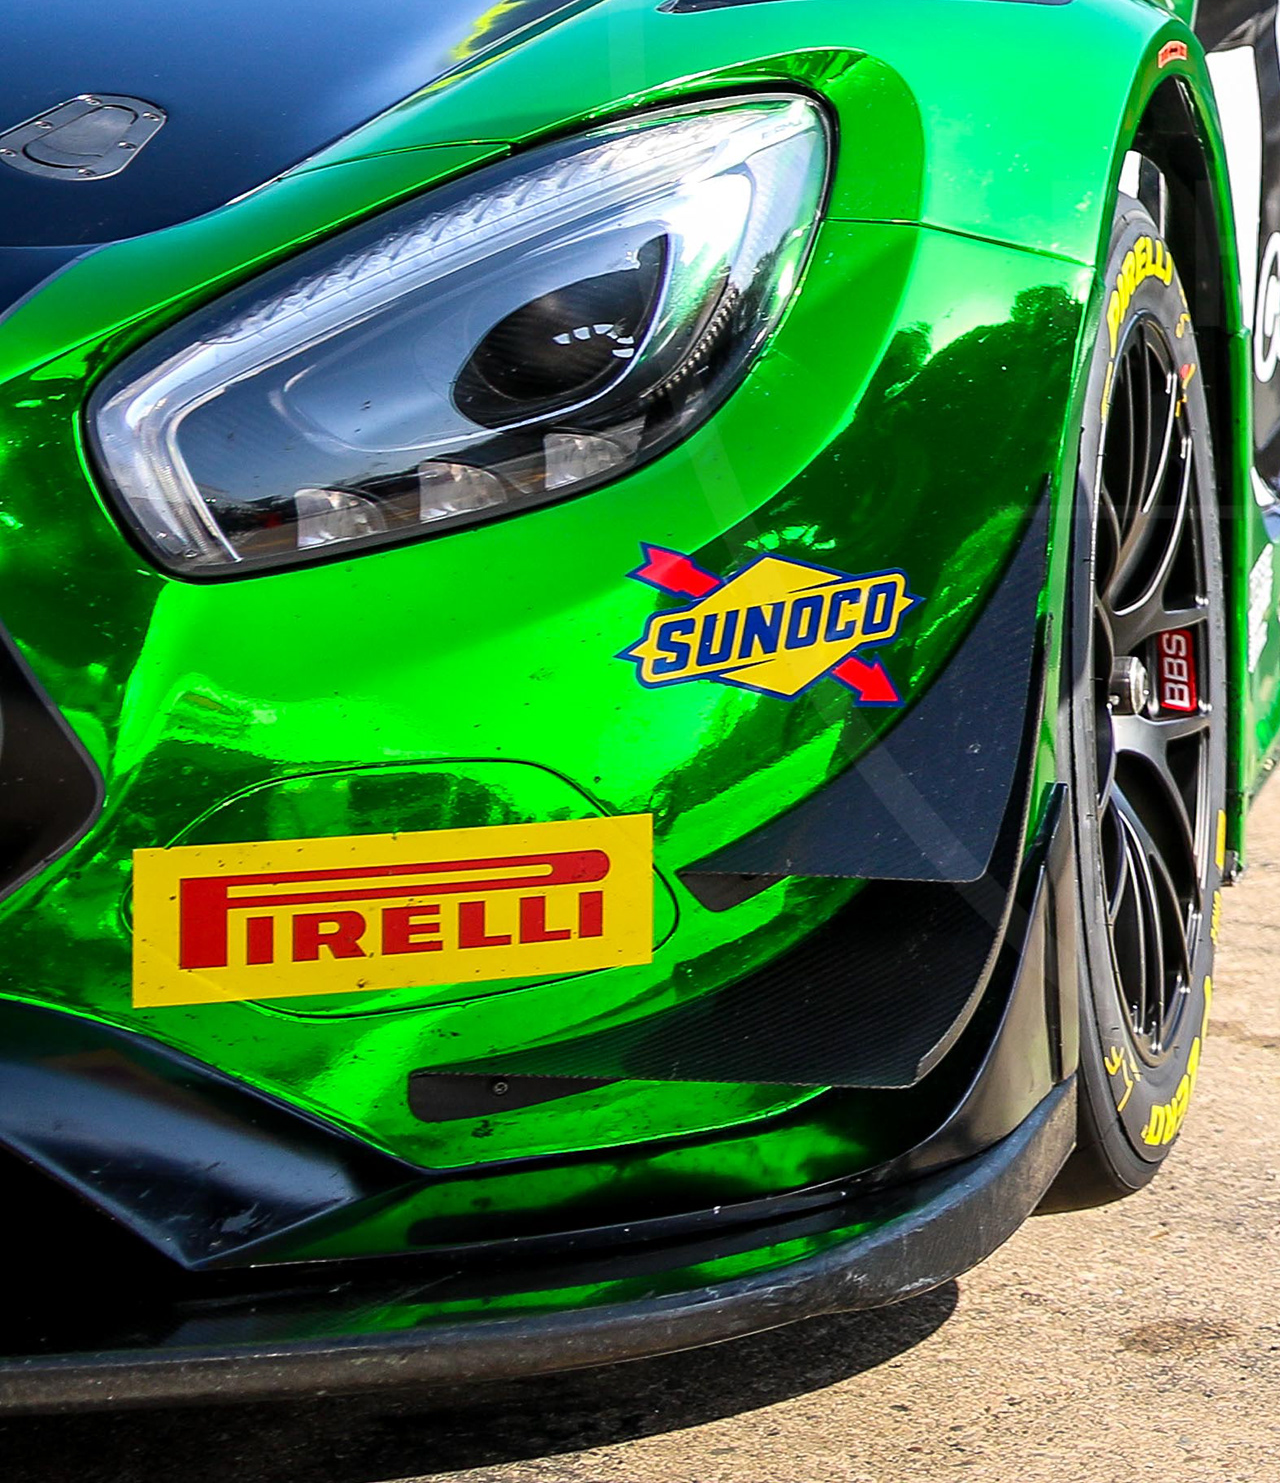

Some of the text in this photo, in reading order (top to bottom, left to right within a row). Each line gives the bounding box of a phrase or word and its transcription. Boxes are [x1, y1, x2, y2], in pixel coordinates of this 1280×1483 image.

[1106, 235, 1174, 359] PIRELLI
[650, 580, 898, 676] SUNOCO
[1163, 630, 1192, 709] BBS
[178, 848, 611, 971] PIRELLI
